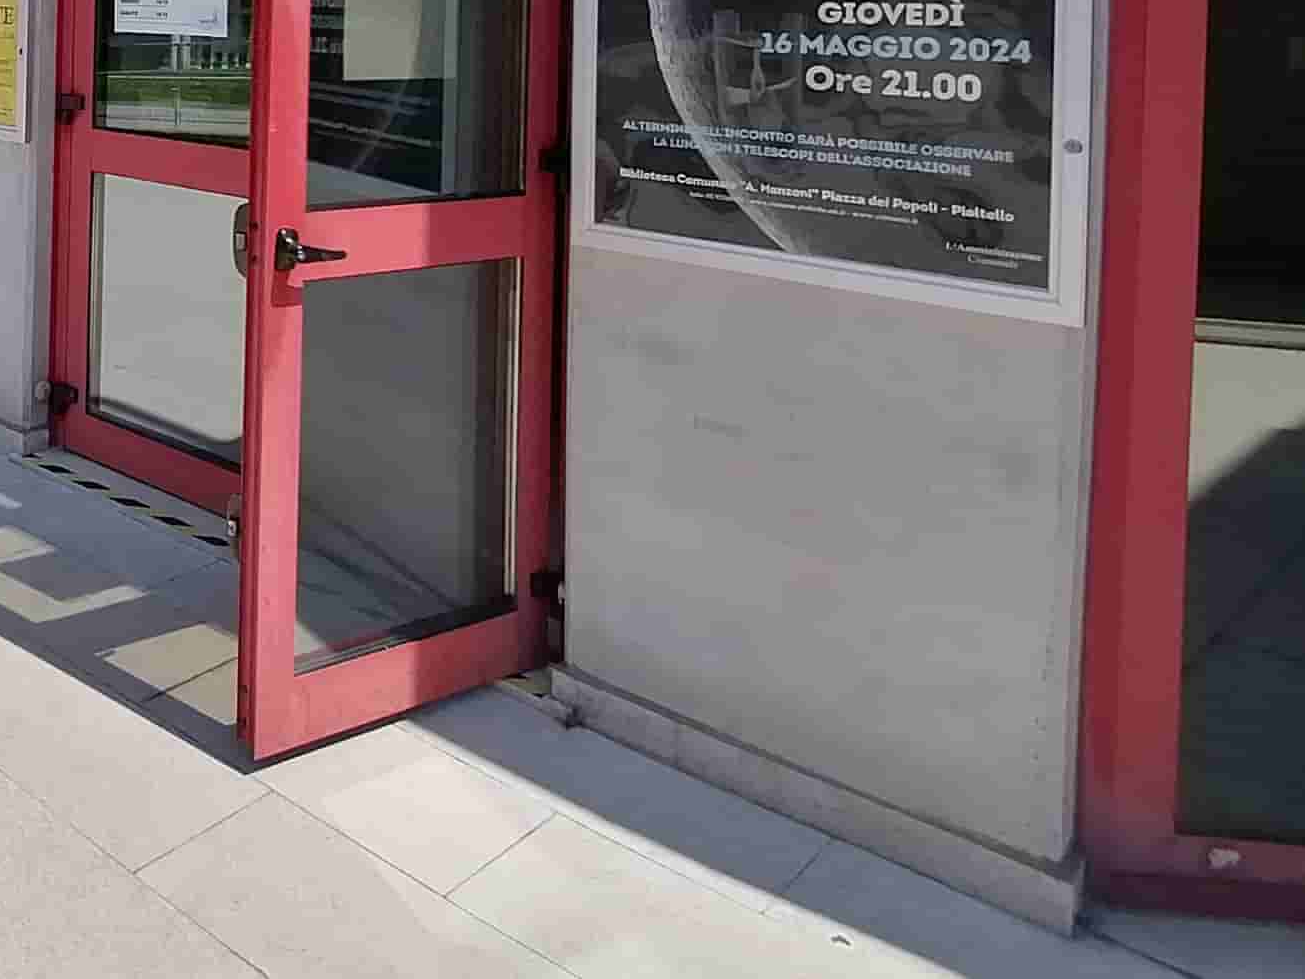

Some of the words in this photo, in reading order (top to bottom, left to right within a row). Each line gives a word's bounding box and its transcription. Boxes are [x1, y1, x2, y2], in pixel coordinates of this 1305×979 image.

[760, 31, 792, 55] 16
[799, 33, 941, 60] MAGGIO
[948, 36, 1032, 63] 2024
[805, 65, 872, 94] Ore
[881, 69, 983, 102] 21.00
[742, 144, 814, 162] TELESCOPI
[838, 136, 918, 156] POSSIBILE
[921, 143, 1014, 164] OSSERVARE
